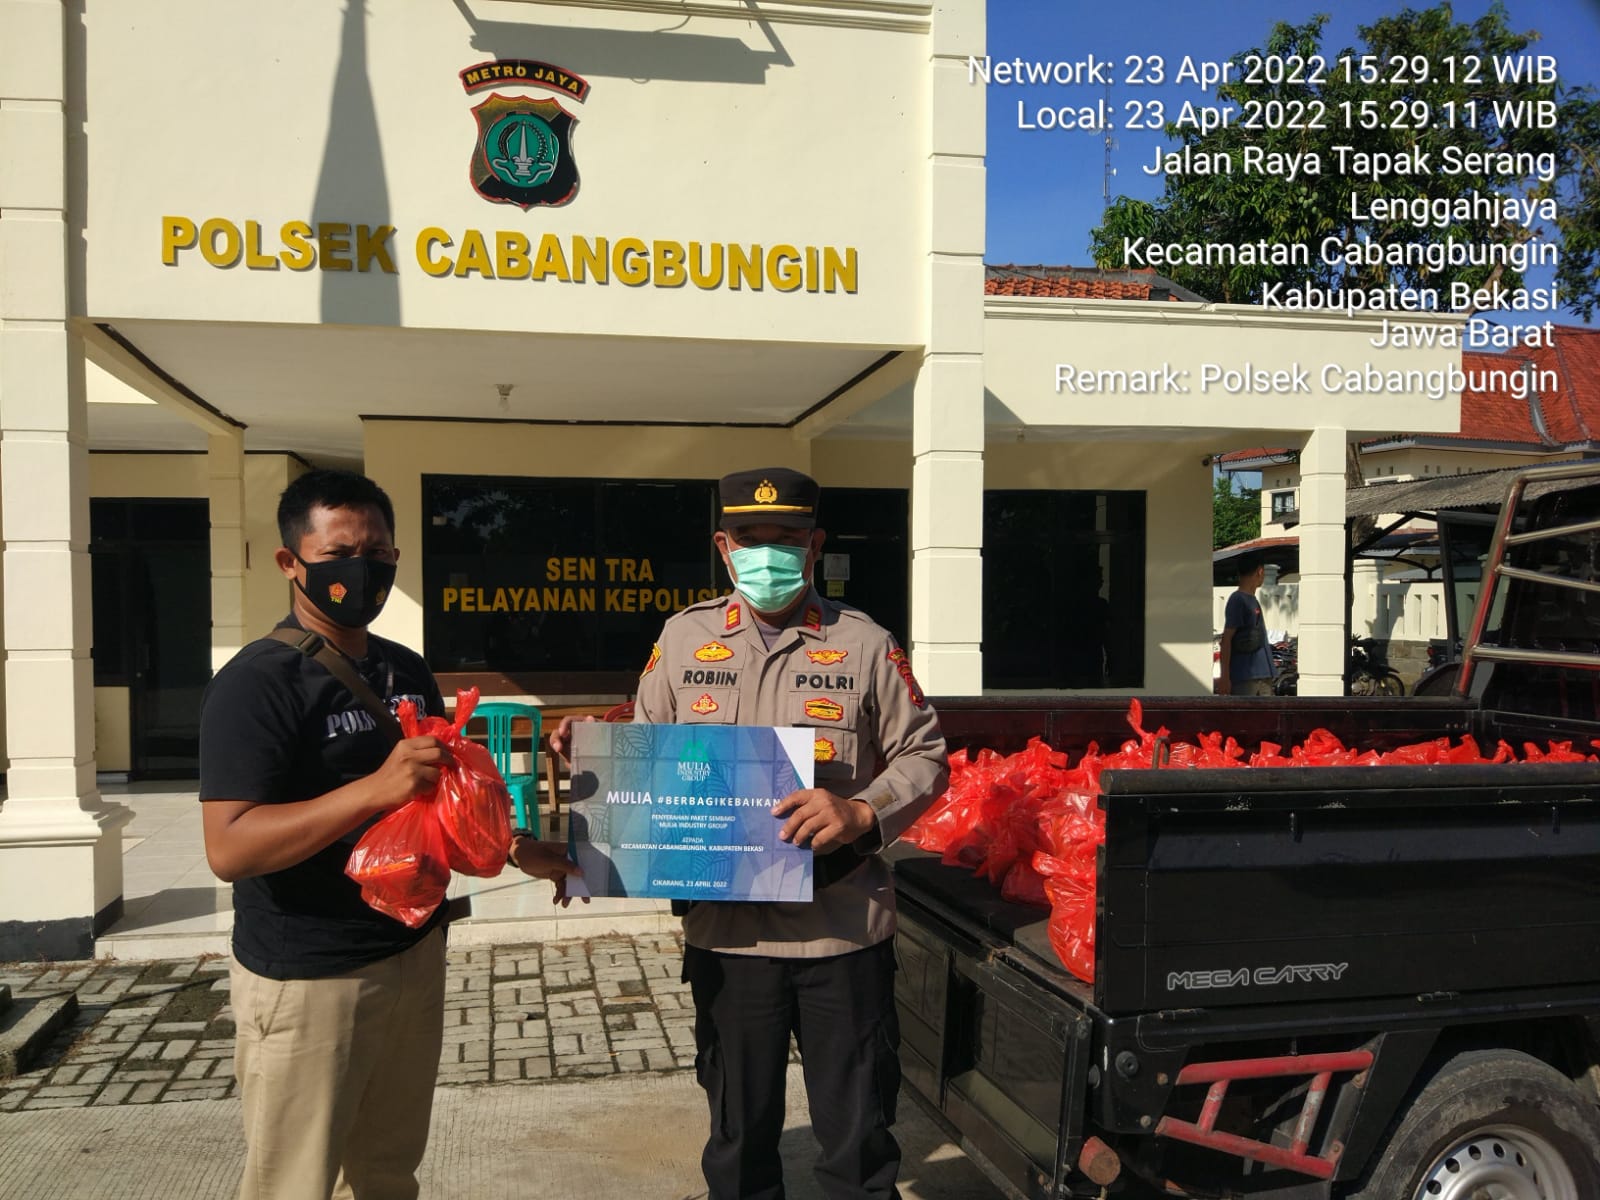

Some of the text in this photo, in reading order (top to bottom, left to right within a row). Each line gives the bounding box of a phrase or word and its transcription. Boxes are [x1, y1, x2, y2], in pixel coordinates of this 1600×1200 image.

[466, 65, 580, 93] METRO JAYA
[162, 215, 857, 293] POLSEK CABANGBUNGIN
[546, 557, 654, 582] SEN TRA
[443, 588, 595, 612] PELAYANAN
[683, 670, 738, 686] ROBIIN
[795, 674, 854, 690] POLRI
[677, 762, 711, 771] MULIA
[606, 791, 782, 807] MULIA #BERBAGIKEBAIKAN
[1167, 962, 1349, 991] MEGA CARRY
